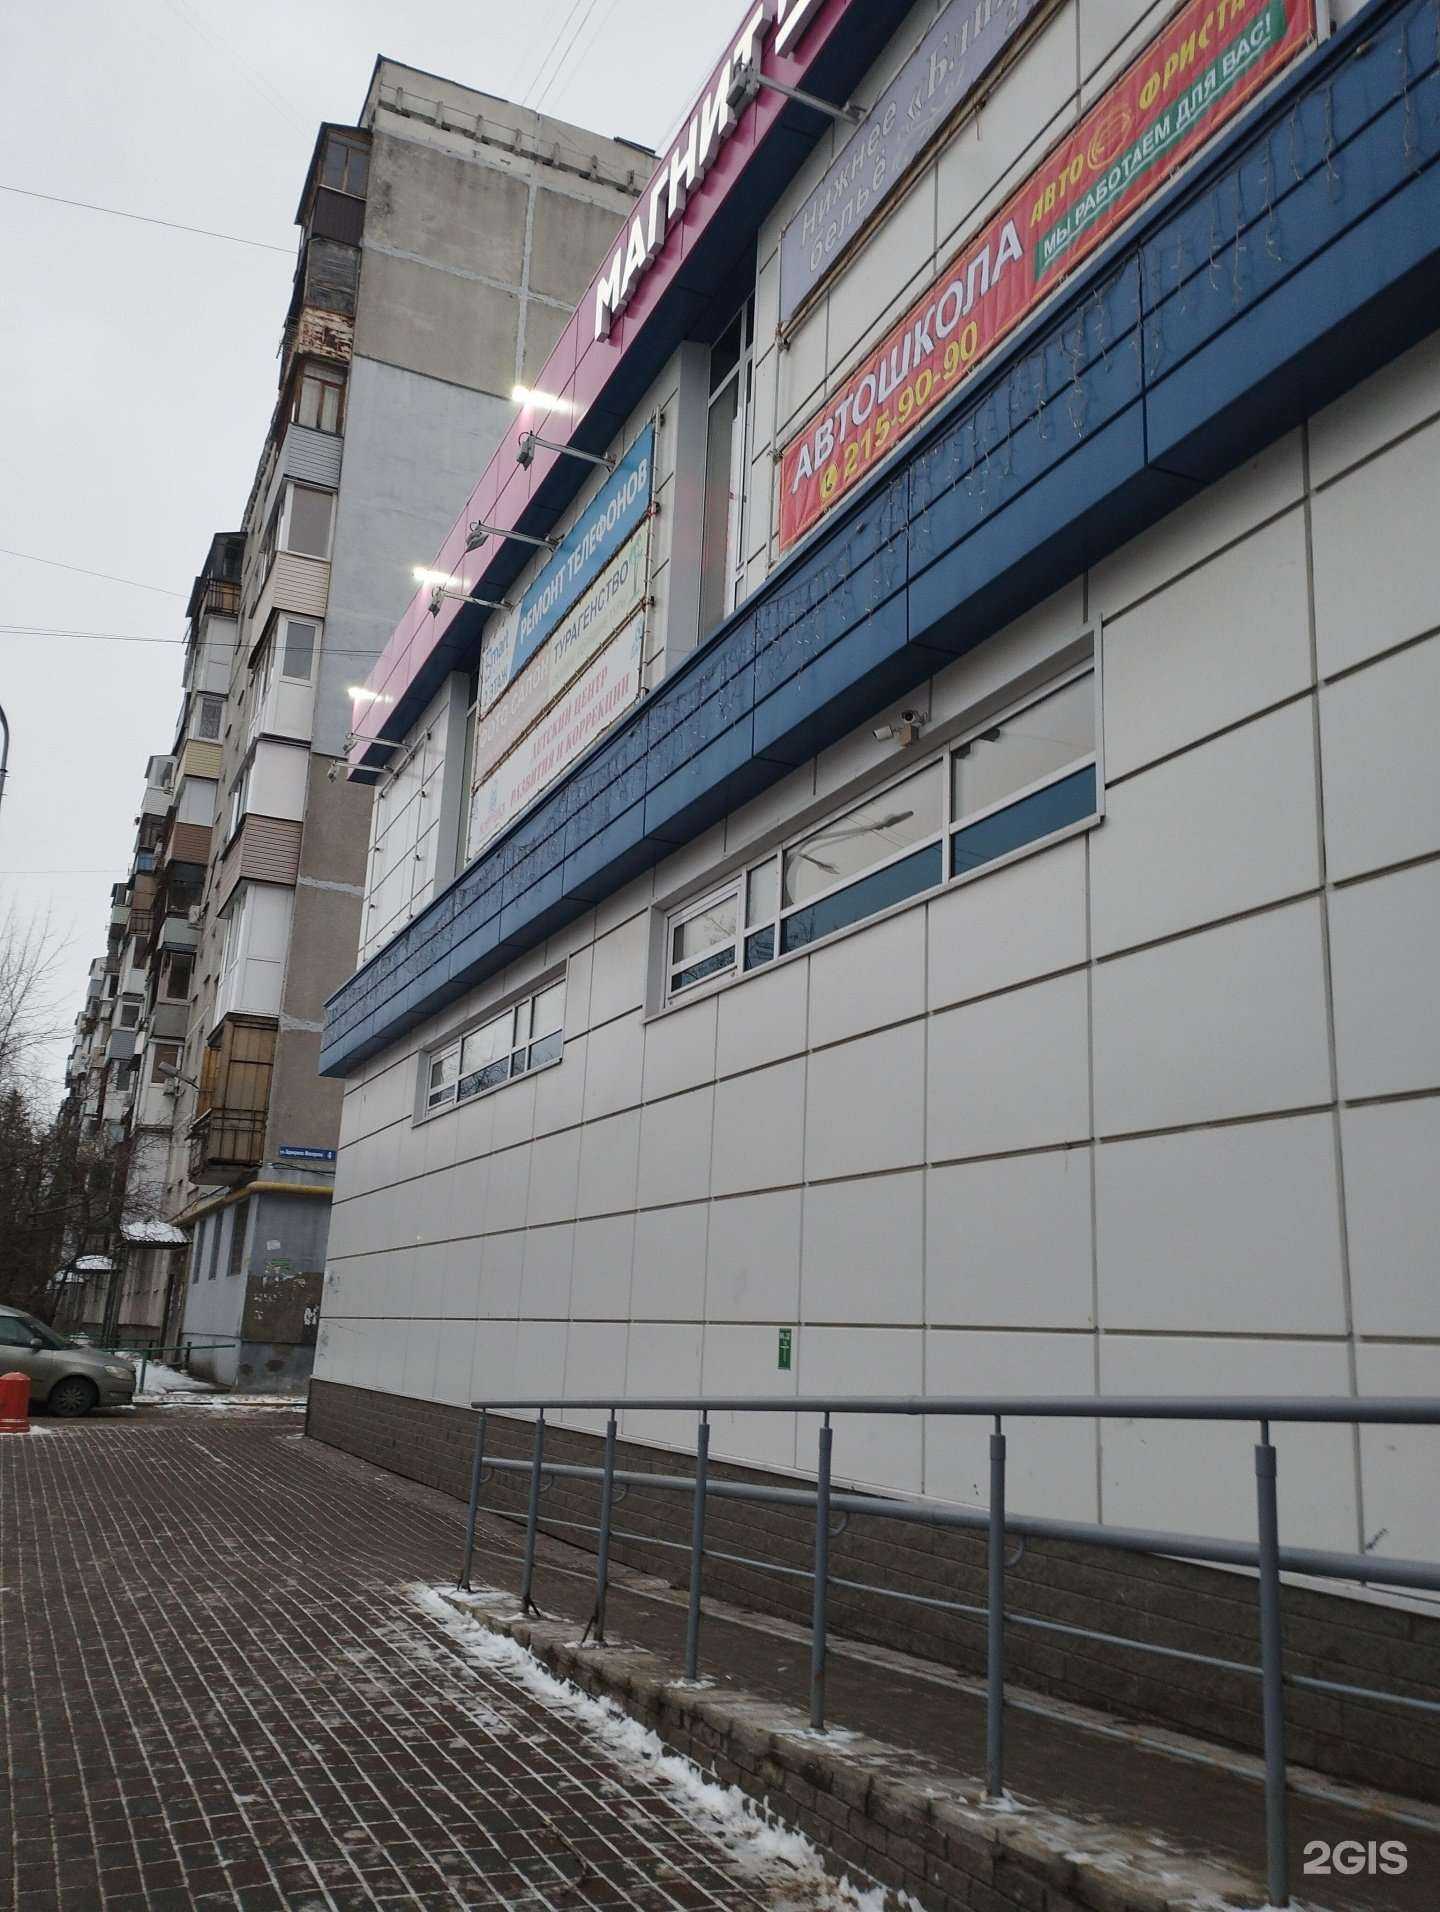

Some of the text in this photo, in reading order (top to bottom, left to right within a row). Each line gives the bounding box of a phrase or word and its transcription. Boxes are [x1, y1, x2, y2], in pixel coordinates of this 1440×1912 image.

[803, 103, 897, 244] Нижнее
[810, 152, 886, 273] бельё
[1043, 13, 1271, 258] МЫ РАБОТАЕМ ДЛЯ ВАС!
[791, 219, 1024, 495] АВТОШКОЛА
[520, 458, 648, 644] РЕМОНТ ТЕЛЕФОНОВ
[554, 559, 629, 664] ТУРАГЕНСТВО
